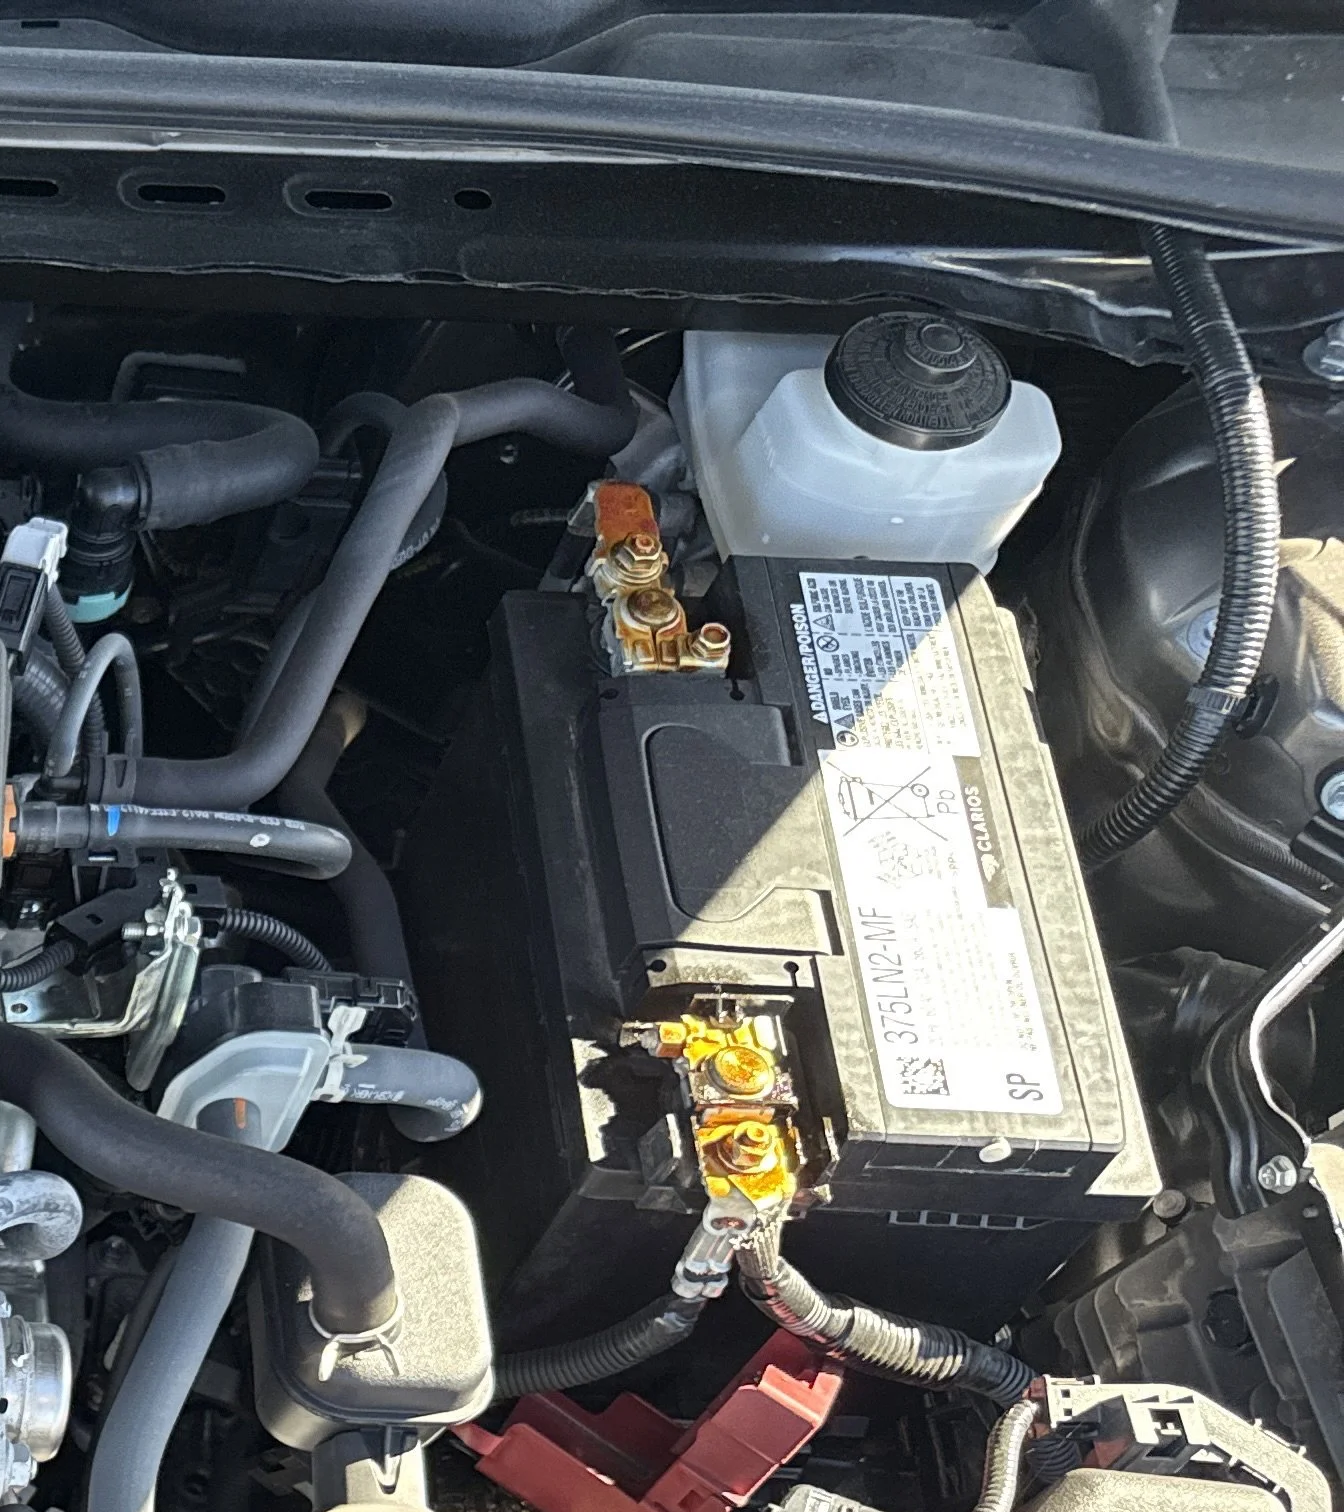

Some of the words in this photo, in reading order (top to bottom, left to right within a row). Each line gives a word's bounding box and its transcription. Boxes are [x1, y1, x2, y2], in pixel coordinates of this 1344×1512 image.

[790, 603, 826, 711] DANGER/POISON
[936, 789, 960, 814] Pb
[964, 785, 993, 852] CLARIOS
[857, 905, 919, 1045] 375LN2-MF
[1005, 1072, 1044, 1102] SP
